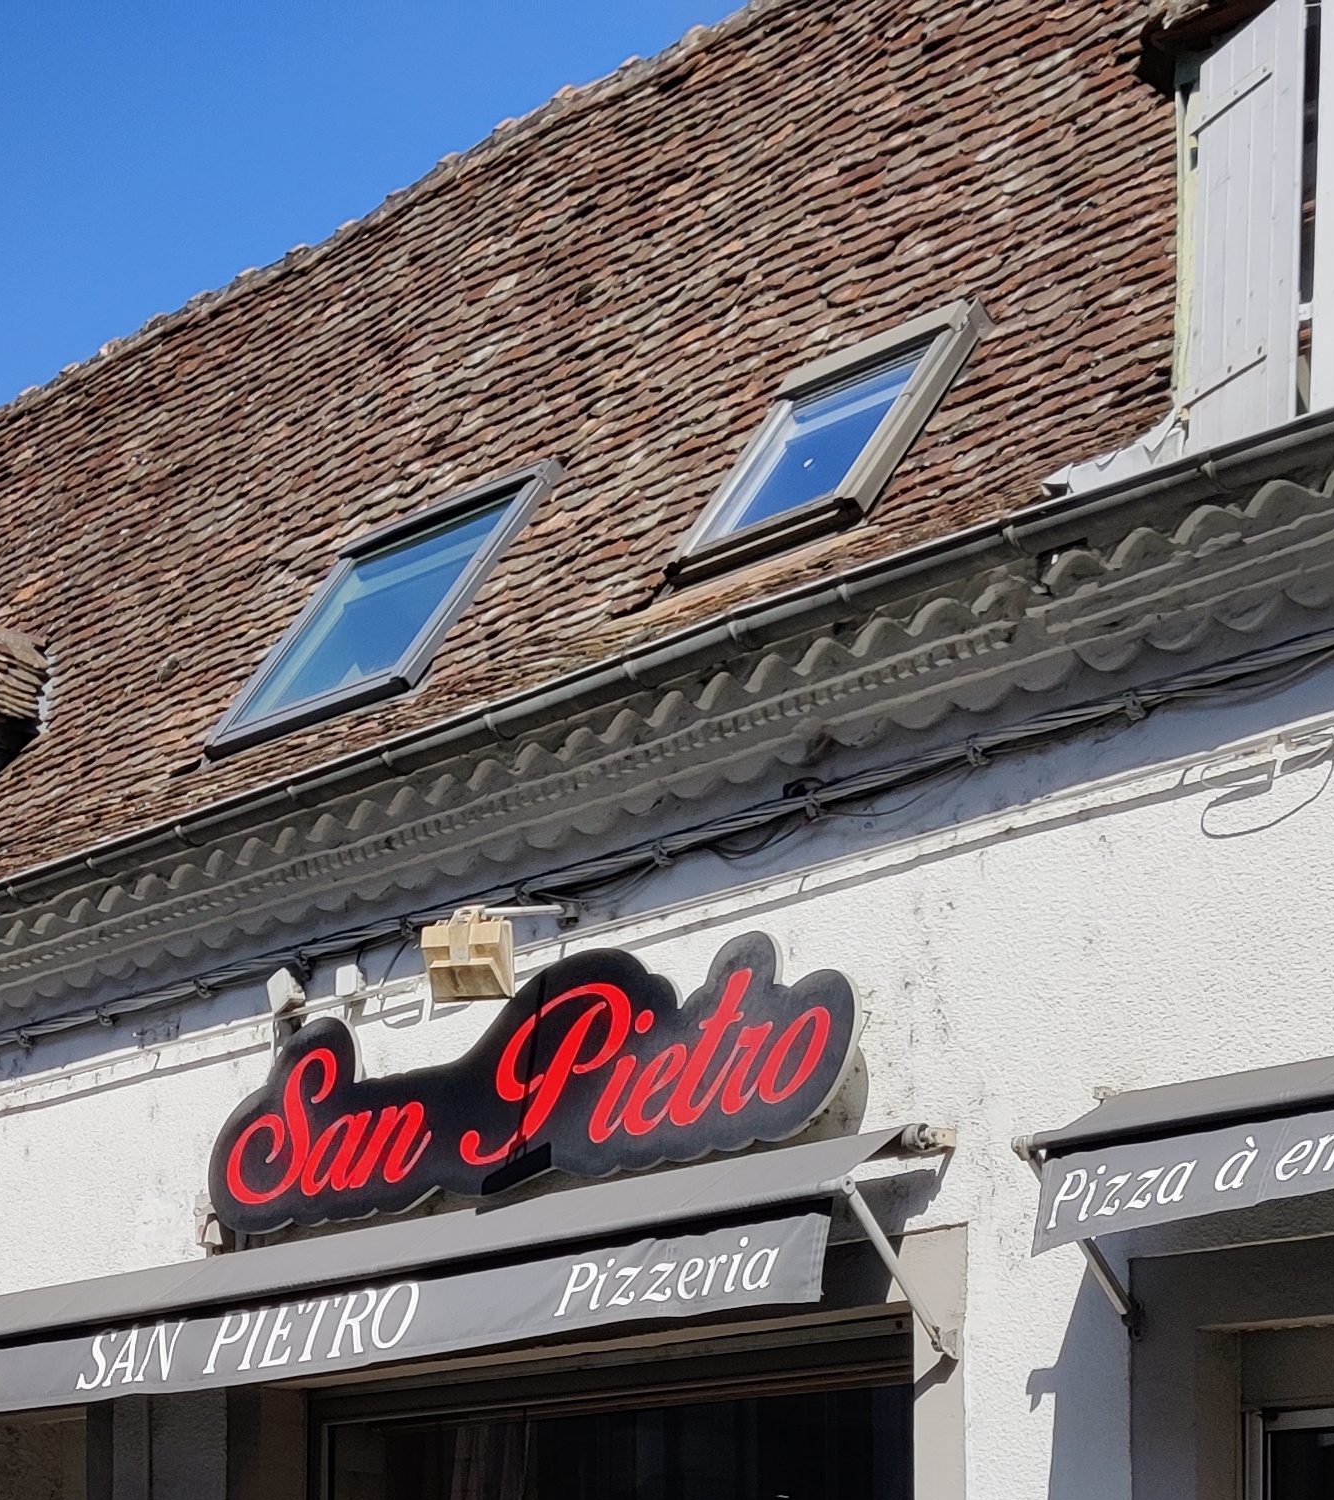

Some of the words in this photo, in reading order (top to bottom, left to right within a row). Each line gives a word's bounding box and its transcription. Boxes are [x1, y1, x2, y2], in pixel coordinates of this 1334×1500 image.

[227, 1048, 431, 1204] San
[460, 968, 831, 1166] Pietro
[1046, 1158, 1197, 1231] Pizza
[1214, 1137, 1259, 1191] à
[76, 1318, 187, 1391] SAN
[203, 1281, 420, 1375] PIETRO
[553, 1237, 780, 1318] Pizzeria
